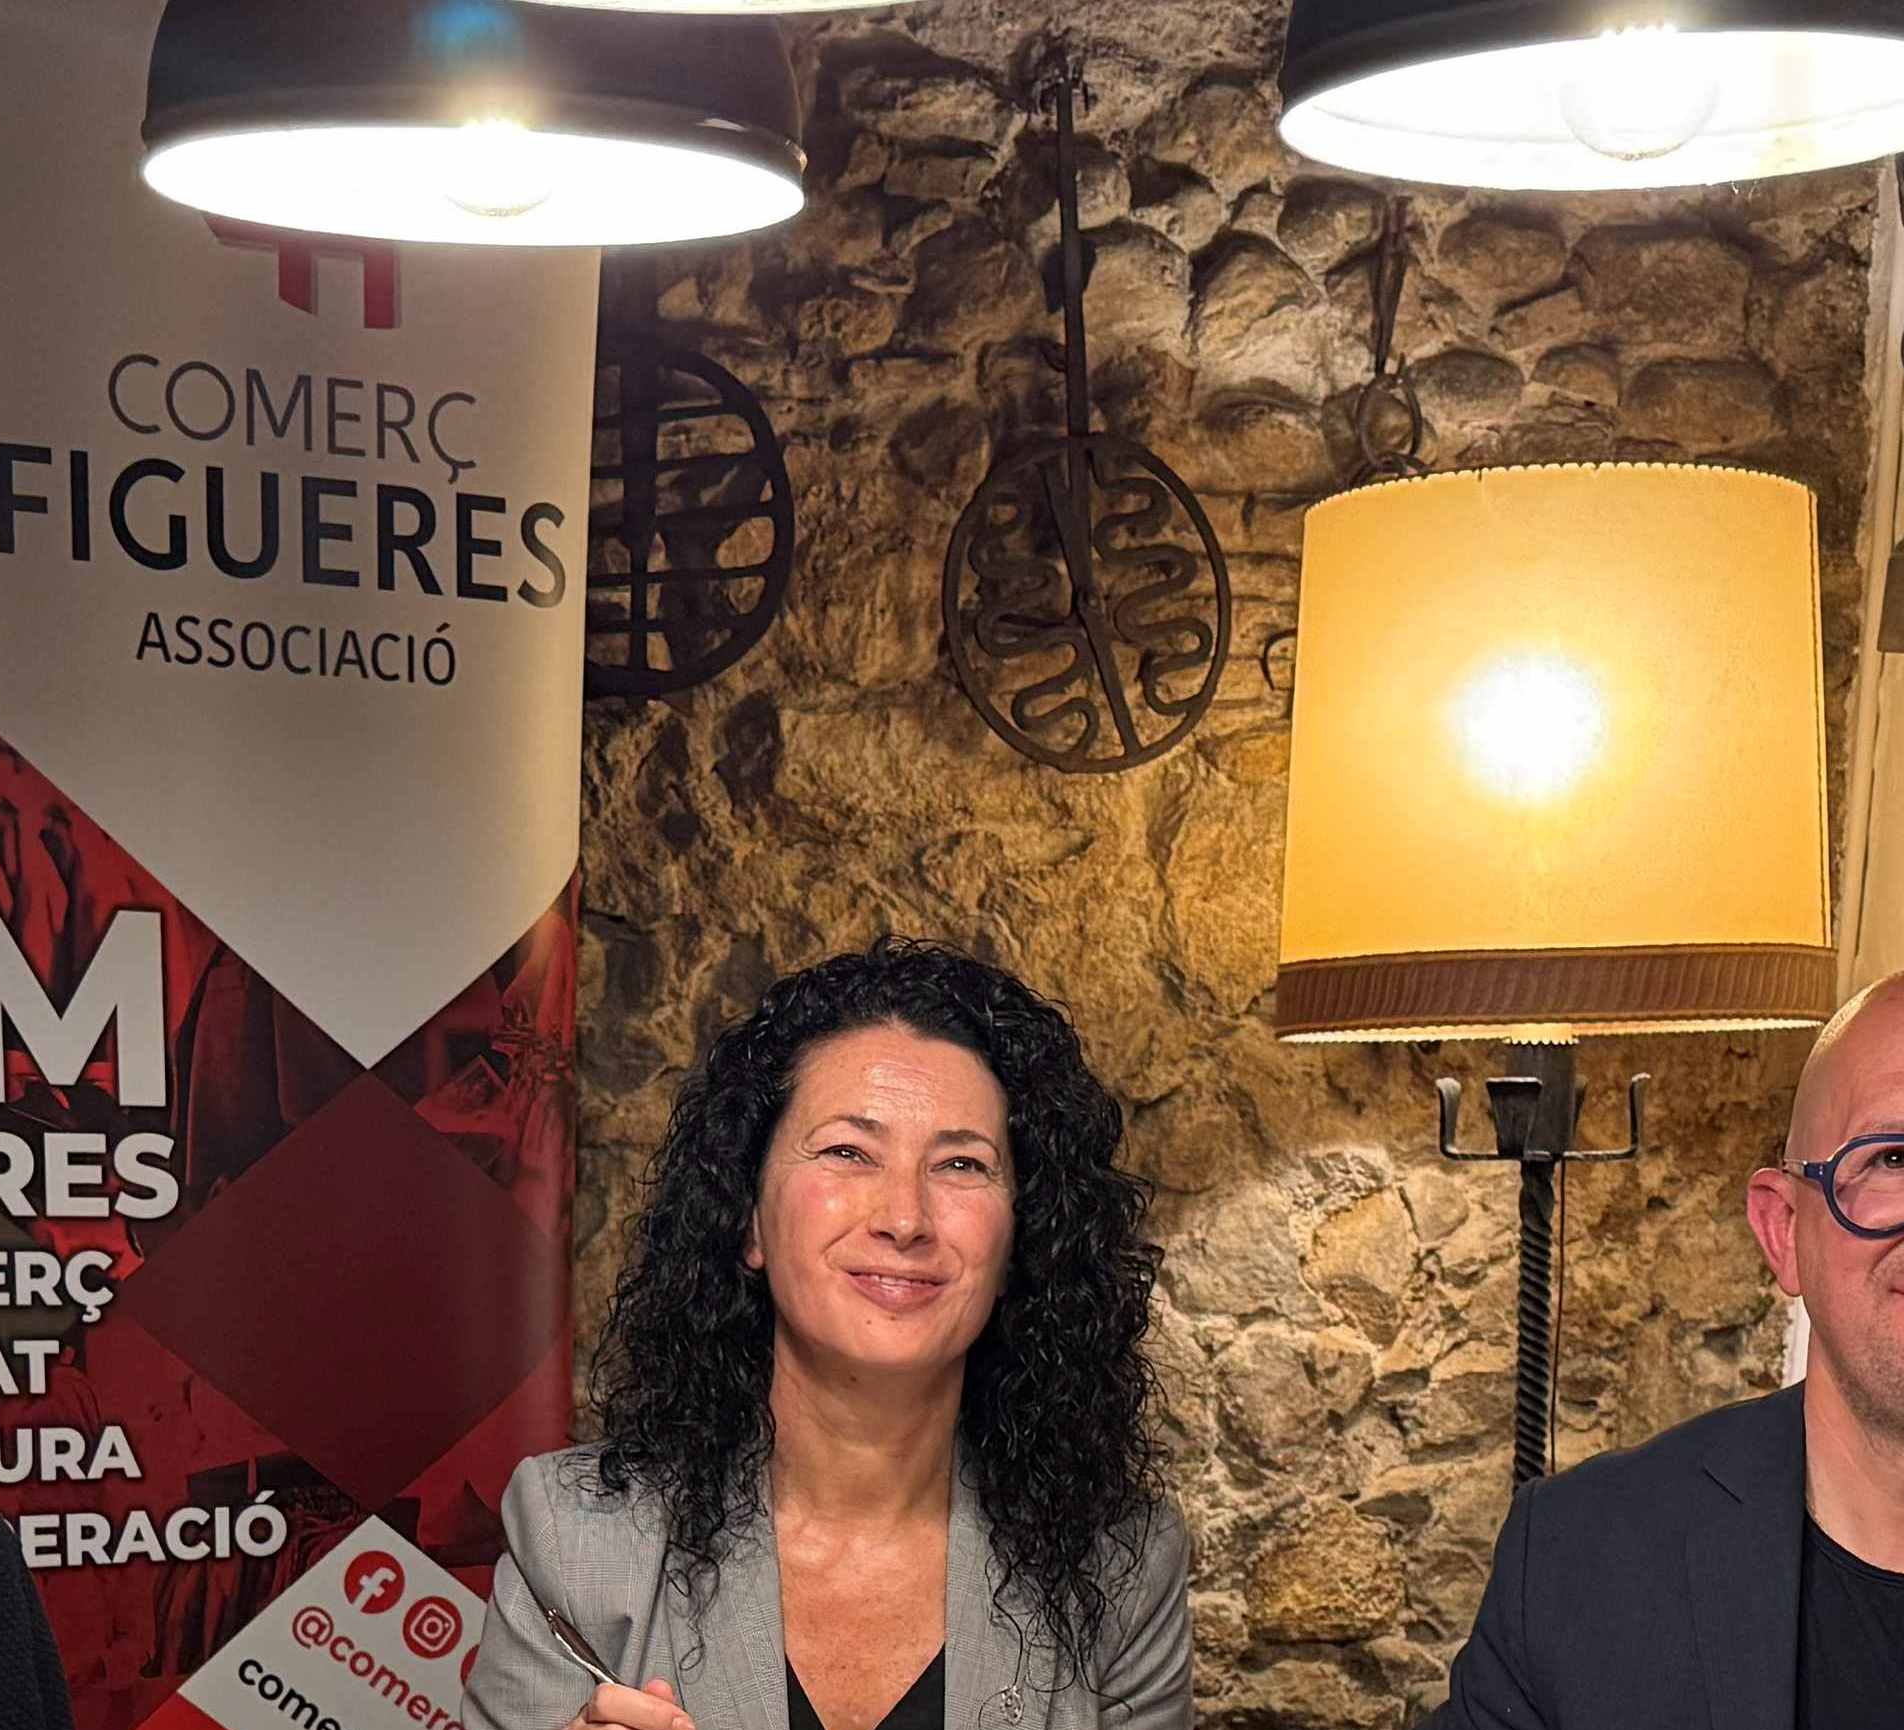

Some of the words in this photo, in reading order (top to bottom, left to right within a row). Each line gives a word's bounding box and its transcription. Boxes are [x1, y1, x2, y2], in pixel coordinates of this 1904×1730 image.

[108, 352, 478, 484] COMERÇ
[135, 611, 457, 687] ASSOCIACIÓ
[12, 1489, 288, 1569] ERACIÓ
